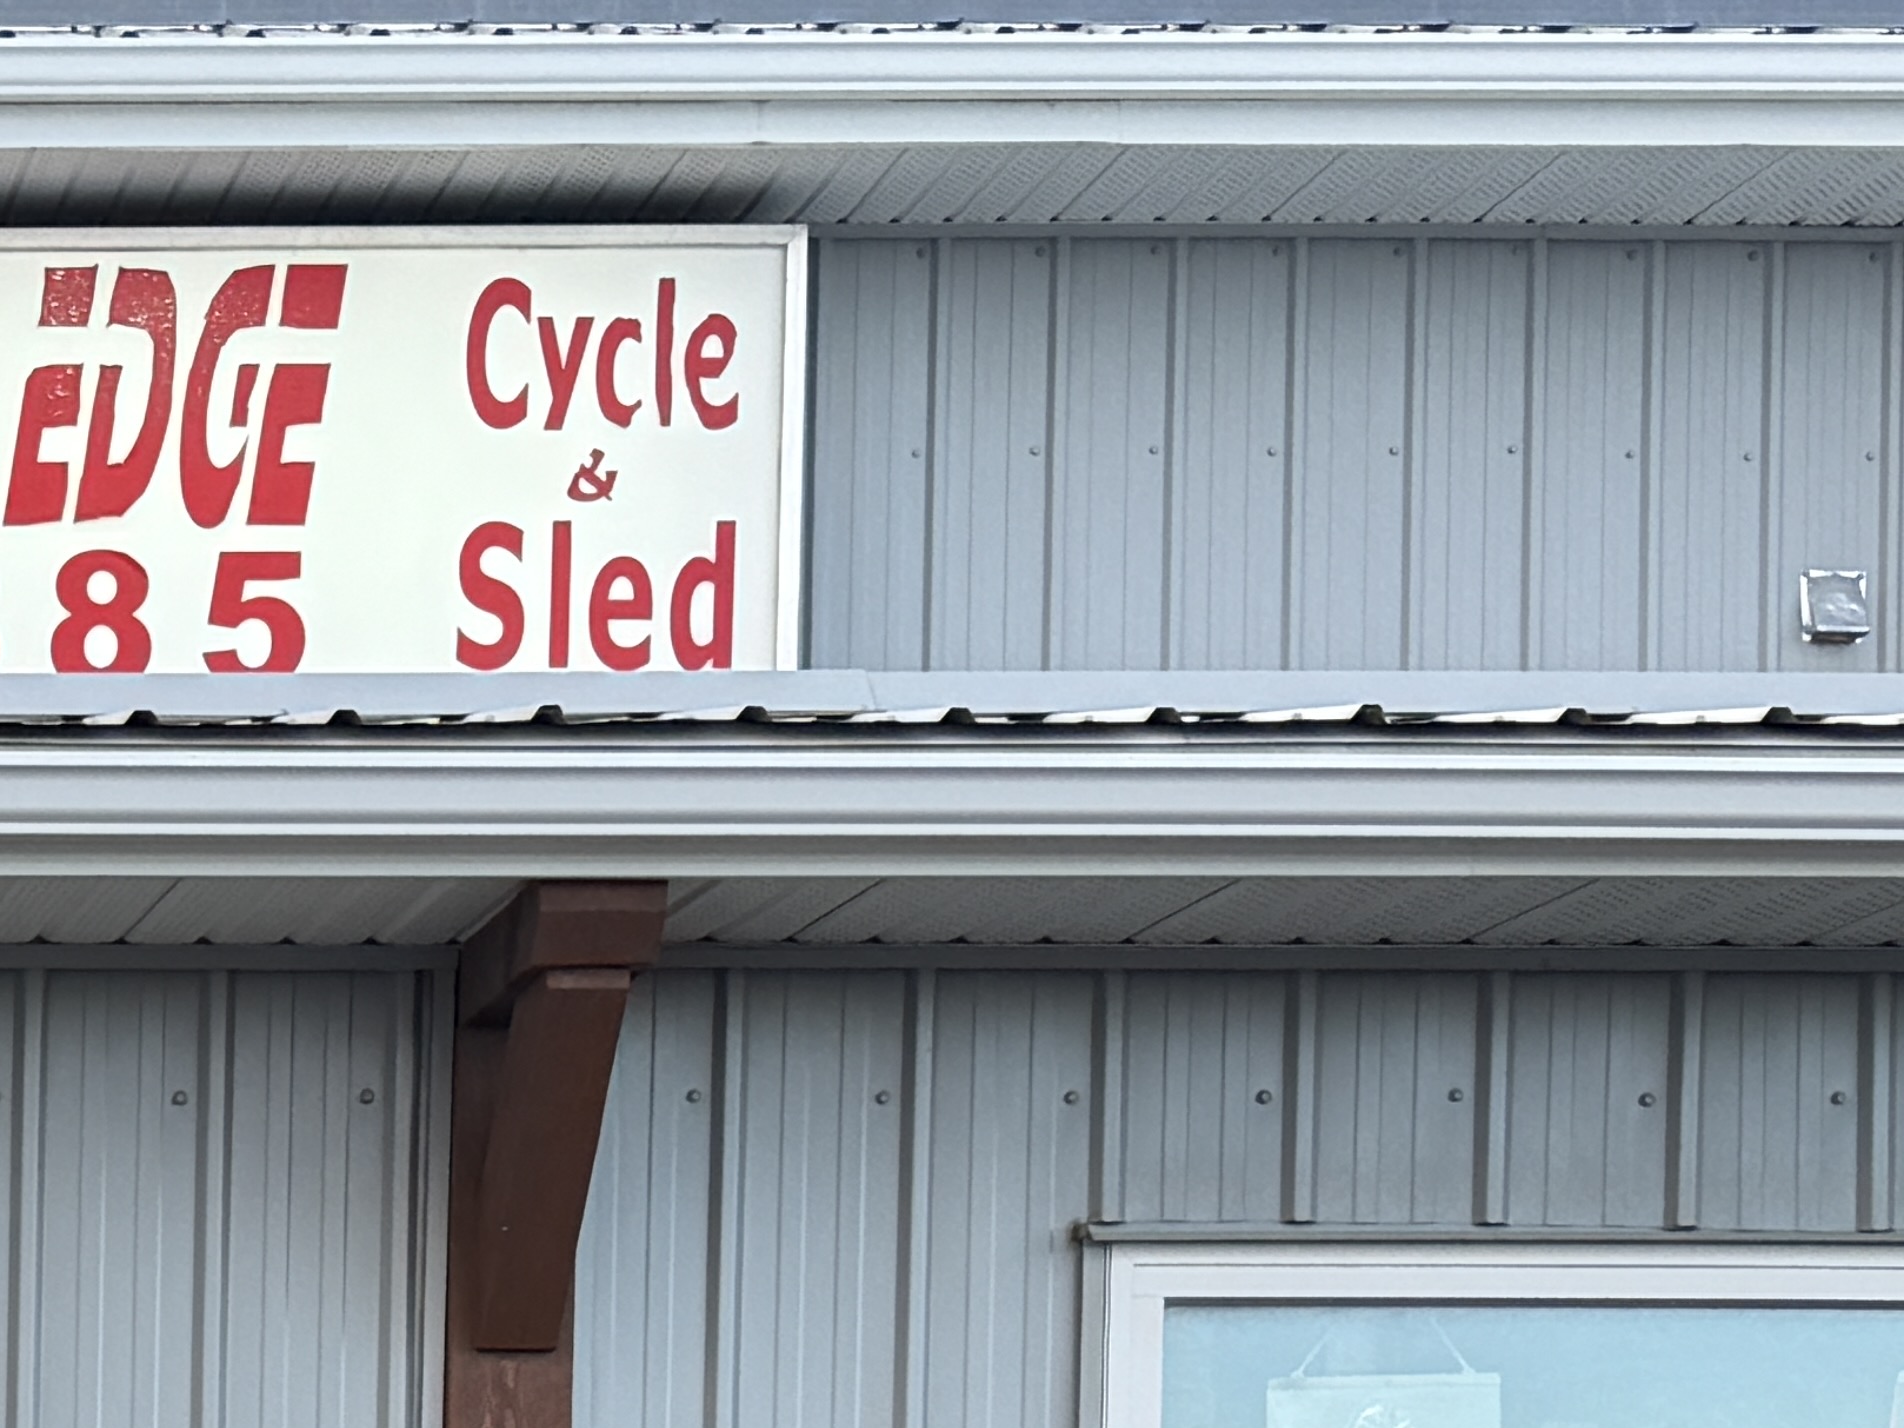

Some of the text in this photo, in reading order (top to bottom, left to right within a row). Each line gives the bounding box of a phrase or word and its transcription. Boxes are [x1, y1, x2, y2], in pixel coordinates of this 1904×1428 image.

[3, 263, 349, 529] EDGE
[466, 277, 740, 431] Cycle
[567, 448, 618, 502] &
[456, 520, 737, 673] Sled
